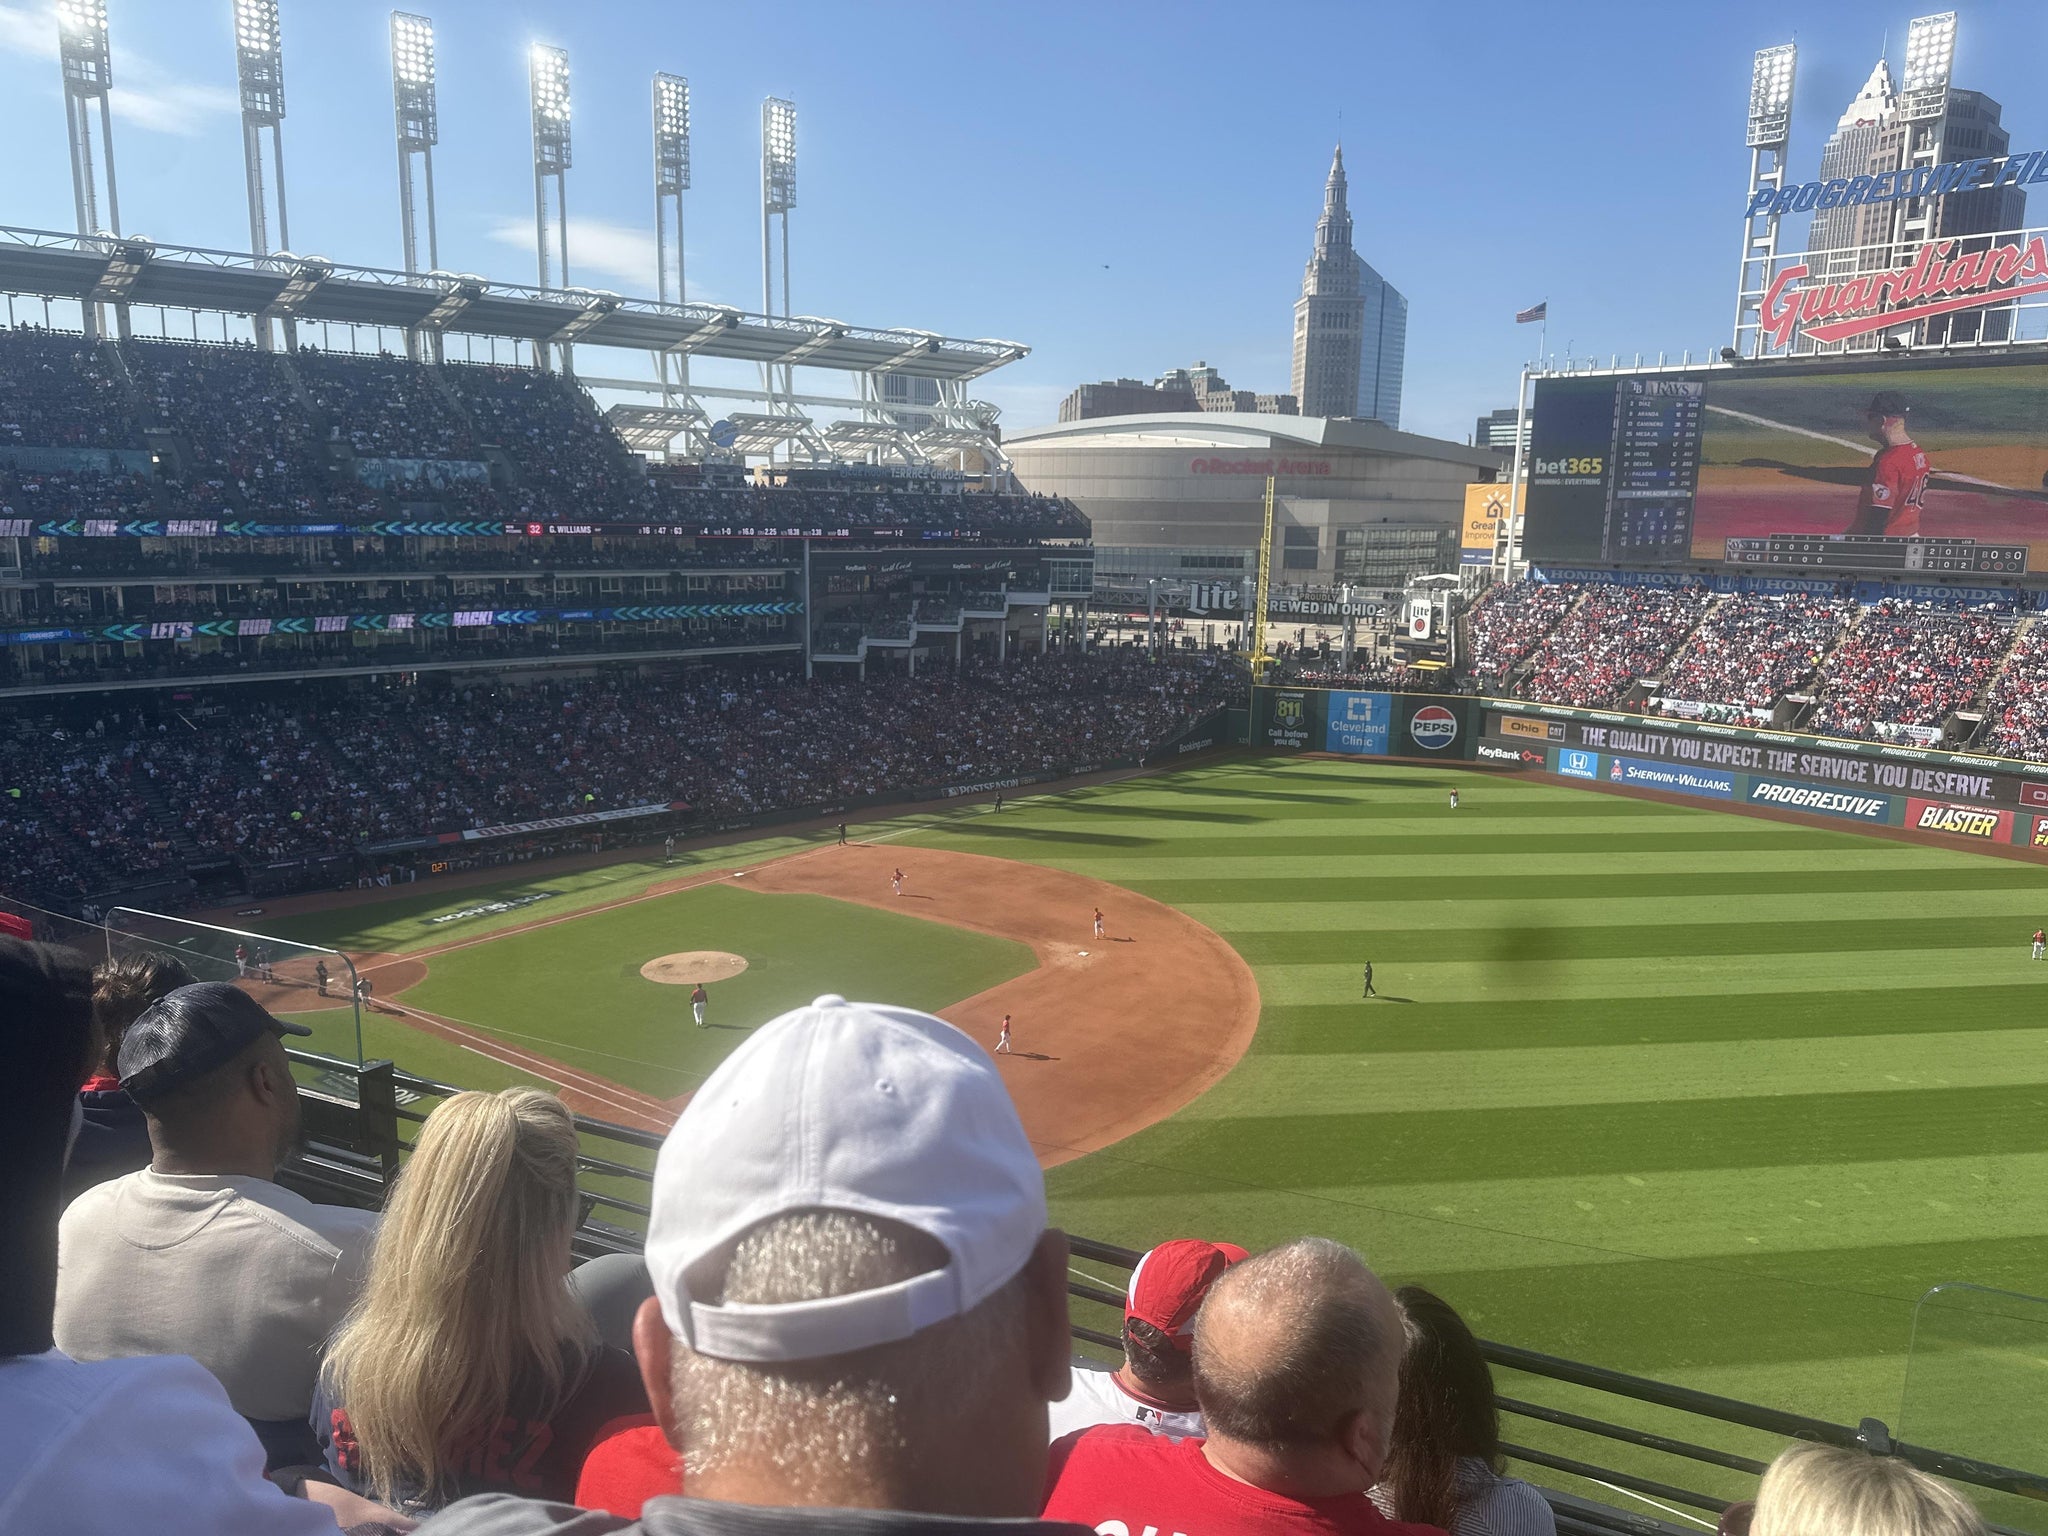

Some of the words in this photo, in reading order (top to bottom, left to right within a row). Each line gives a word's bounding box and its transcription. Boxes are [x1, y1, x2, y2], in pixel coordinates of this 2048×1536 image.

[1745, 156, 1994, 218] PROGRESSIVE
[1760, 236, 2048, 350] Guardians
[1278, 458, 1331, 475] Arena
[1535, 457, 1602, 475] bet365
[890, 467, 928, 479] TERRACE
[930, 469, 965, 481] GARDEN
[1565, 478, 1601, 486] EVERYTHING
[83, 519, 118, 537] ONE
[530, 525, 540, 534] 32
[549, 525, 556, 534] G.
[557, 525, 591, 534] WILLIAMS
[642, 526, 650, 534] 16
[658, 526, 667, 534] 47
[674, 526, 682, 535] 63
[721, 527, 731, 535] 1-0
[1471, 520, 1495, 530] Great
[1819, 544, 1824, 552] 2
[1746, 553, 1760, 561] CLE
[1990, 550, 1998, 559] 0
[2014, 551, 2022, 560] 0
[845, 564, 866, 572] KeyBank
[1551, 570, 1615, 581] HONDA
[1187, 582, 1238, 615] Lite
[1299, 592, 1338, 602] PROUDLY
[1915, 586, 2005, 601] HONDA
[1266, 599, 1319, 614] REWED
[1323, 602, 1338, 615] IN
[1341, 603, 1377, 616] OHIO
[1413, 605, 1430, 618] Lite
[151, 621, 194, 639] LET'S
[238, 618, 272, 636] RUN
[314, 615, 349, 632] THAT
[452, 610, 493, 627] BACK!
[1278, 700, 1300, 717] 811
[1492, 702, 1526, 710] PROGRESSIVE
[1540, 707, 1576, 716] PROGRESSIVE
[1590, 712, 1626, 722] PROGRESSIVE
[1642, 718, 1681, 729] PROGRESSIVE
[1268, 728, 1282, 737] Call
[1284, 730, 1308, 739] before
[1332, 720, 1386, 734] Cleveland
[1414, 721, 1455, 734] PEPSI
[1511, 722, 1539, 733] Ohio
[1549, 726, 1563, 737] CAT
[1697, 725, 1738, 736] PROGRESSIVE
[1274, 738, 1287, 746] you
[1288, 739, 1301, 748] dig.
[1342, 735, 1373, 747] Clinic
[1755, 732, 1797, 743] PROGRESSIVE
[1179, 737, 1213, 754] Booking.com
[1816, 739, 1861, 751] PROGRESSIVE
[1478, 746, 1521, 760] KeyBank
[1881, 747, 1928, 759] PROGRESSIVE
[1581, 726, 1608, 747] THE
[1609, 730, 1669, 755] QUALITY
[1671, 737, 1701, 760] YOU
[1703, 742, 1763, 769] EXPECT.
[1767, 749, 1798, 773] THE
[1800, 754, 1869, 783] SERVICE
[1873, 763, 1907, 788] YOU
[1910, 768, 1996, 800] DESERVE.
[1949, 755, 1999, 768] PROGRESSIVE
[1561, 767, 1593, 777] HONDA
[960, 778, 1019, 795] POSTSEASON
[1752, 783, 1884, 816] PROGRESSIVE
[1918, 806, 1998, 836] BLASTER
